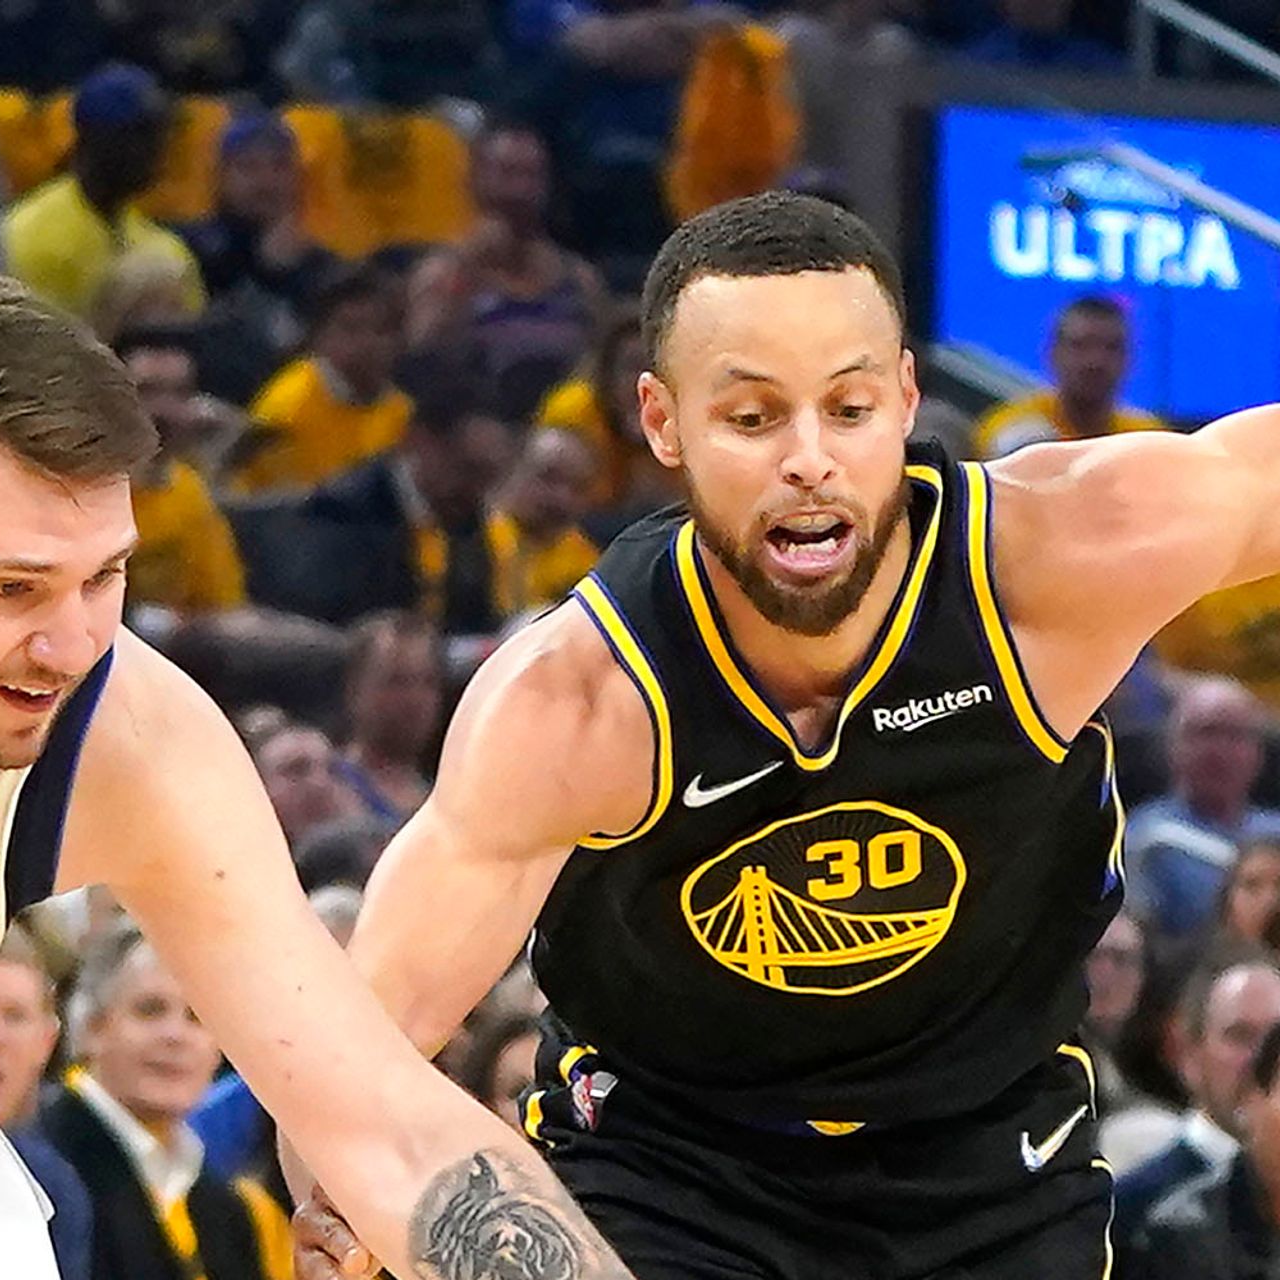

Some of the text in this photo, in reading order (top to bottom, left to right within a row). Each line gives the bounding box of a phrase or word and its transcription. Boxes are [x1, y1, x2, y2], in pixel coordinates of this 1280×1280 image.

[988, 202, 1240, 290] ULTRA
[872, 684, 993, 732] Rakuten
[806, 829, 922, 902] 30
